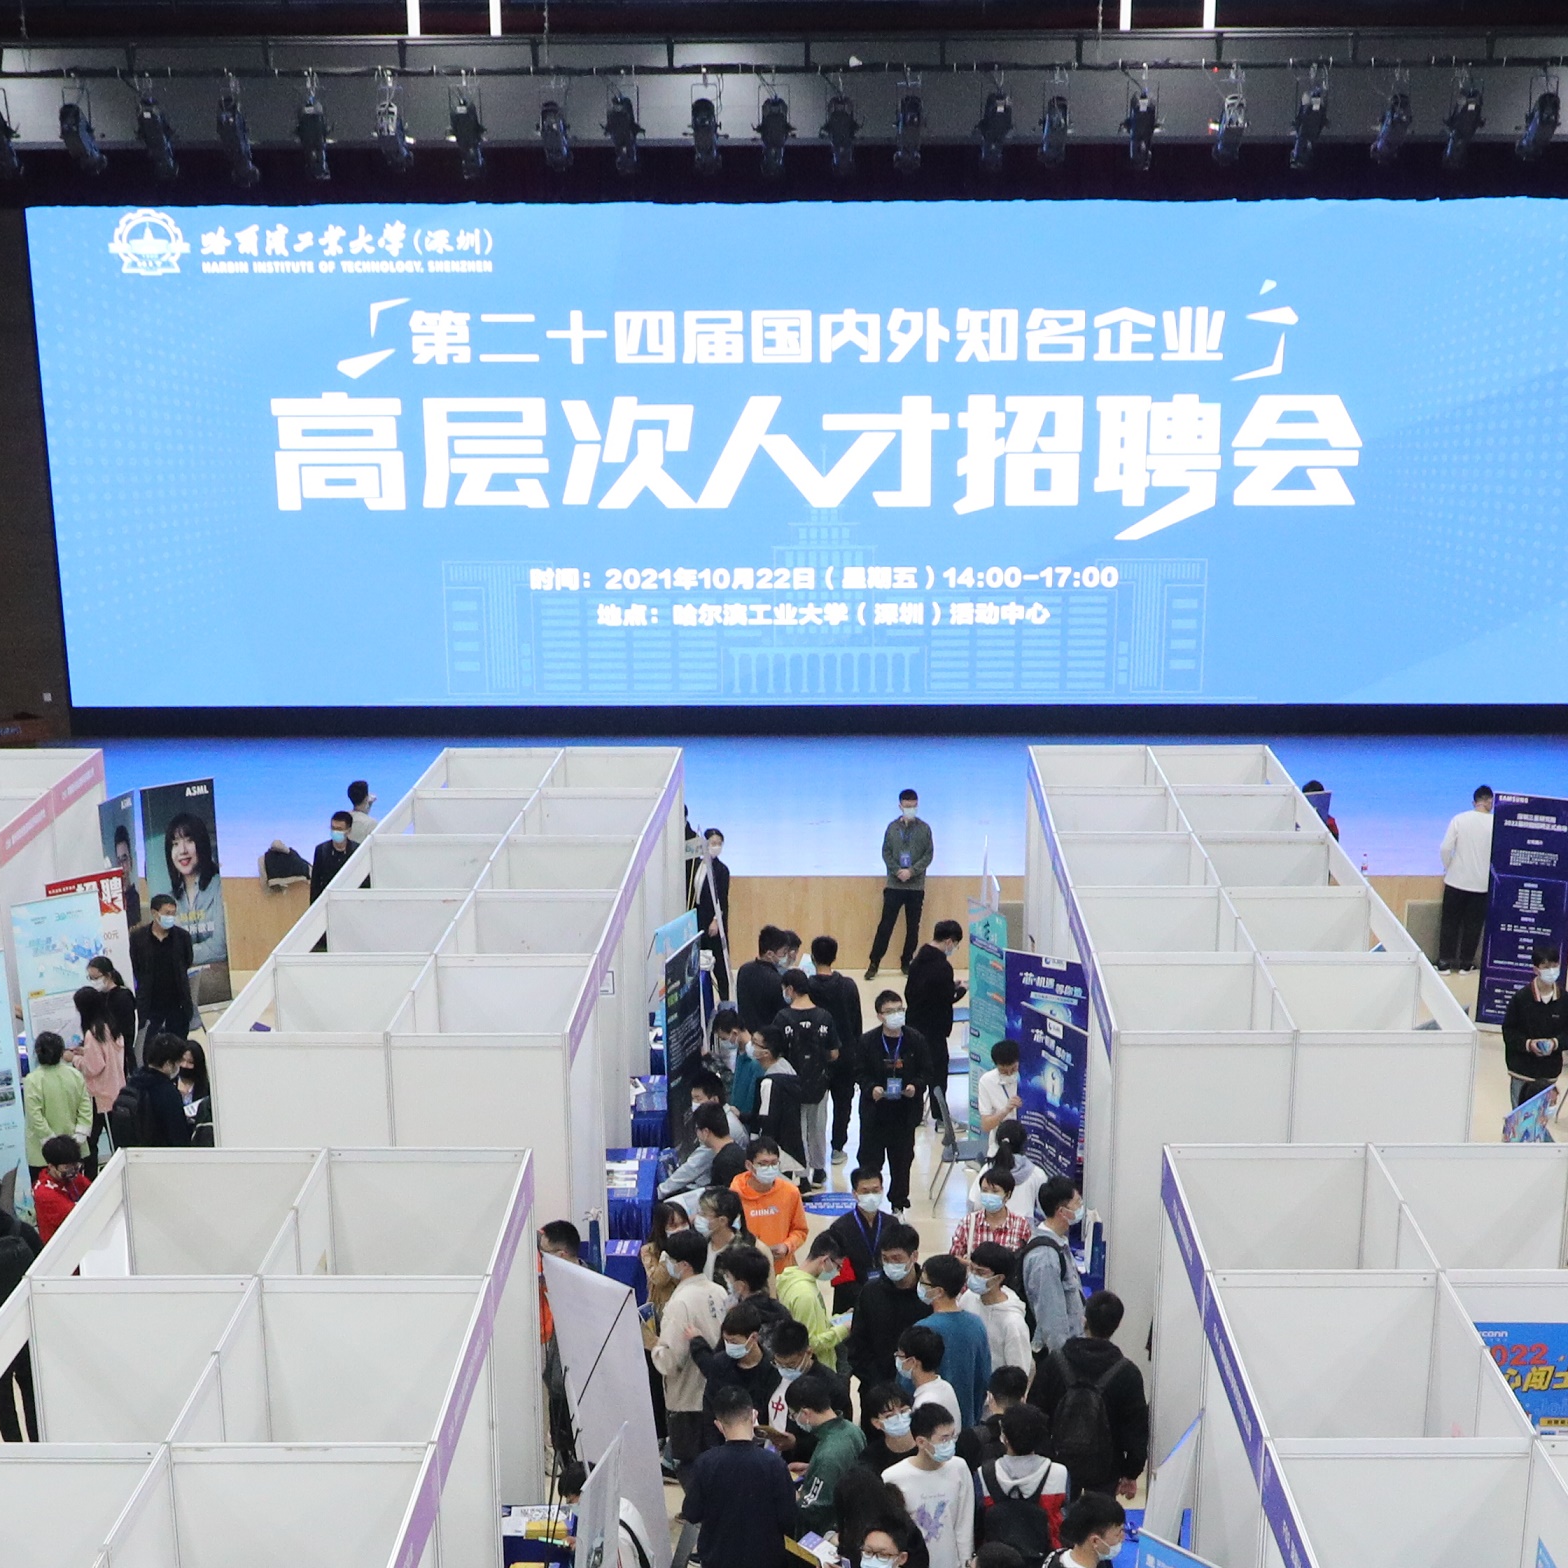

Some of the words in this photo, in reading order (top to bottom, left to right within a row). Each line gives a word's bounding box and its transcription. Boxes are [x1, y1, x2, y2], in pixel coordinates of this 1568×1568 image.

[202, 261, 249, 274] HARBIN
[253, 261, 314, 274] INSTITUTE
[318, 261, 335, 274] OF
[428, 260, 493, 274] SHENZHEN
[409, 306, 1226, 367] 第二十四届国内外知名企业
[270, 391, 1364, 541] 高层次人才招聘会
[185, 784, 209, 797] ASML
[1499, 795, 1529, 803] SAMSUNG
[749, 1208, 775, 1218] CHINA
[1481, 1330, 1508, 1338] conn
[1490, 1343, 1549, 1367] 022
[771, 1395, 785, 1421] 中
